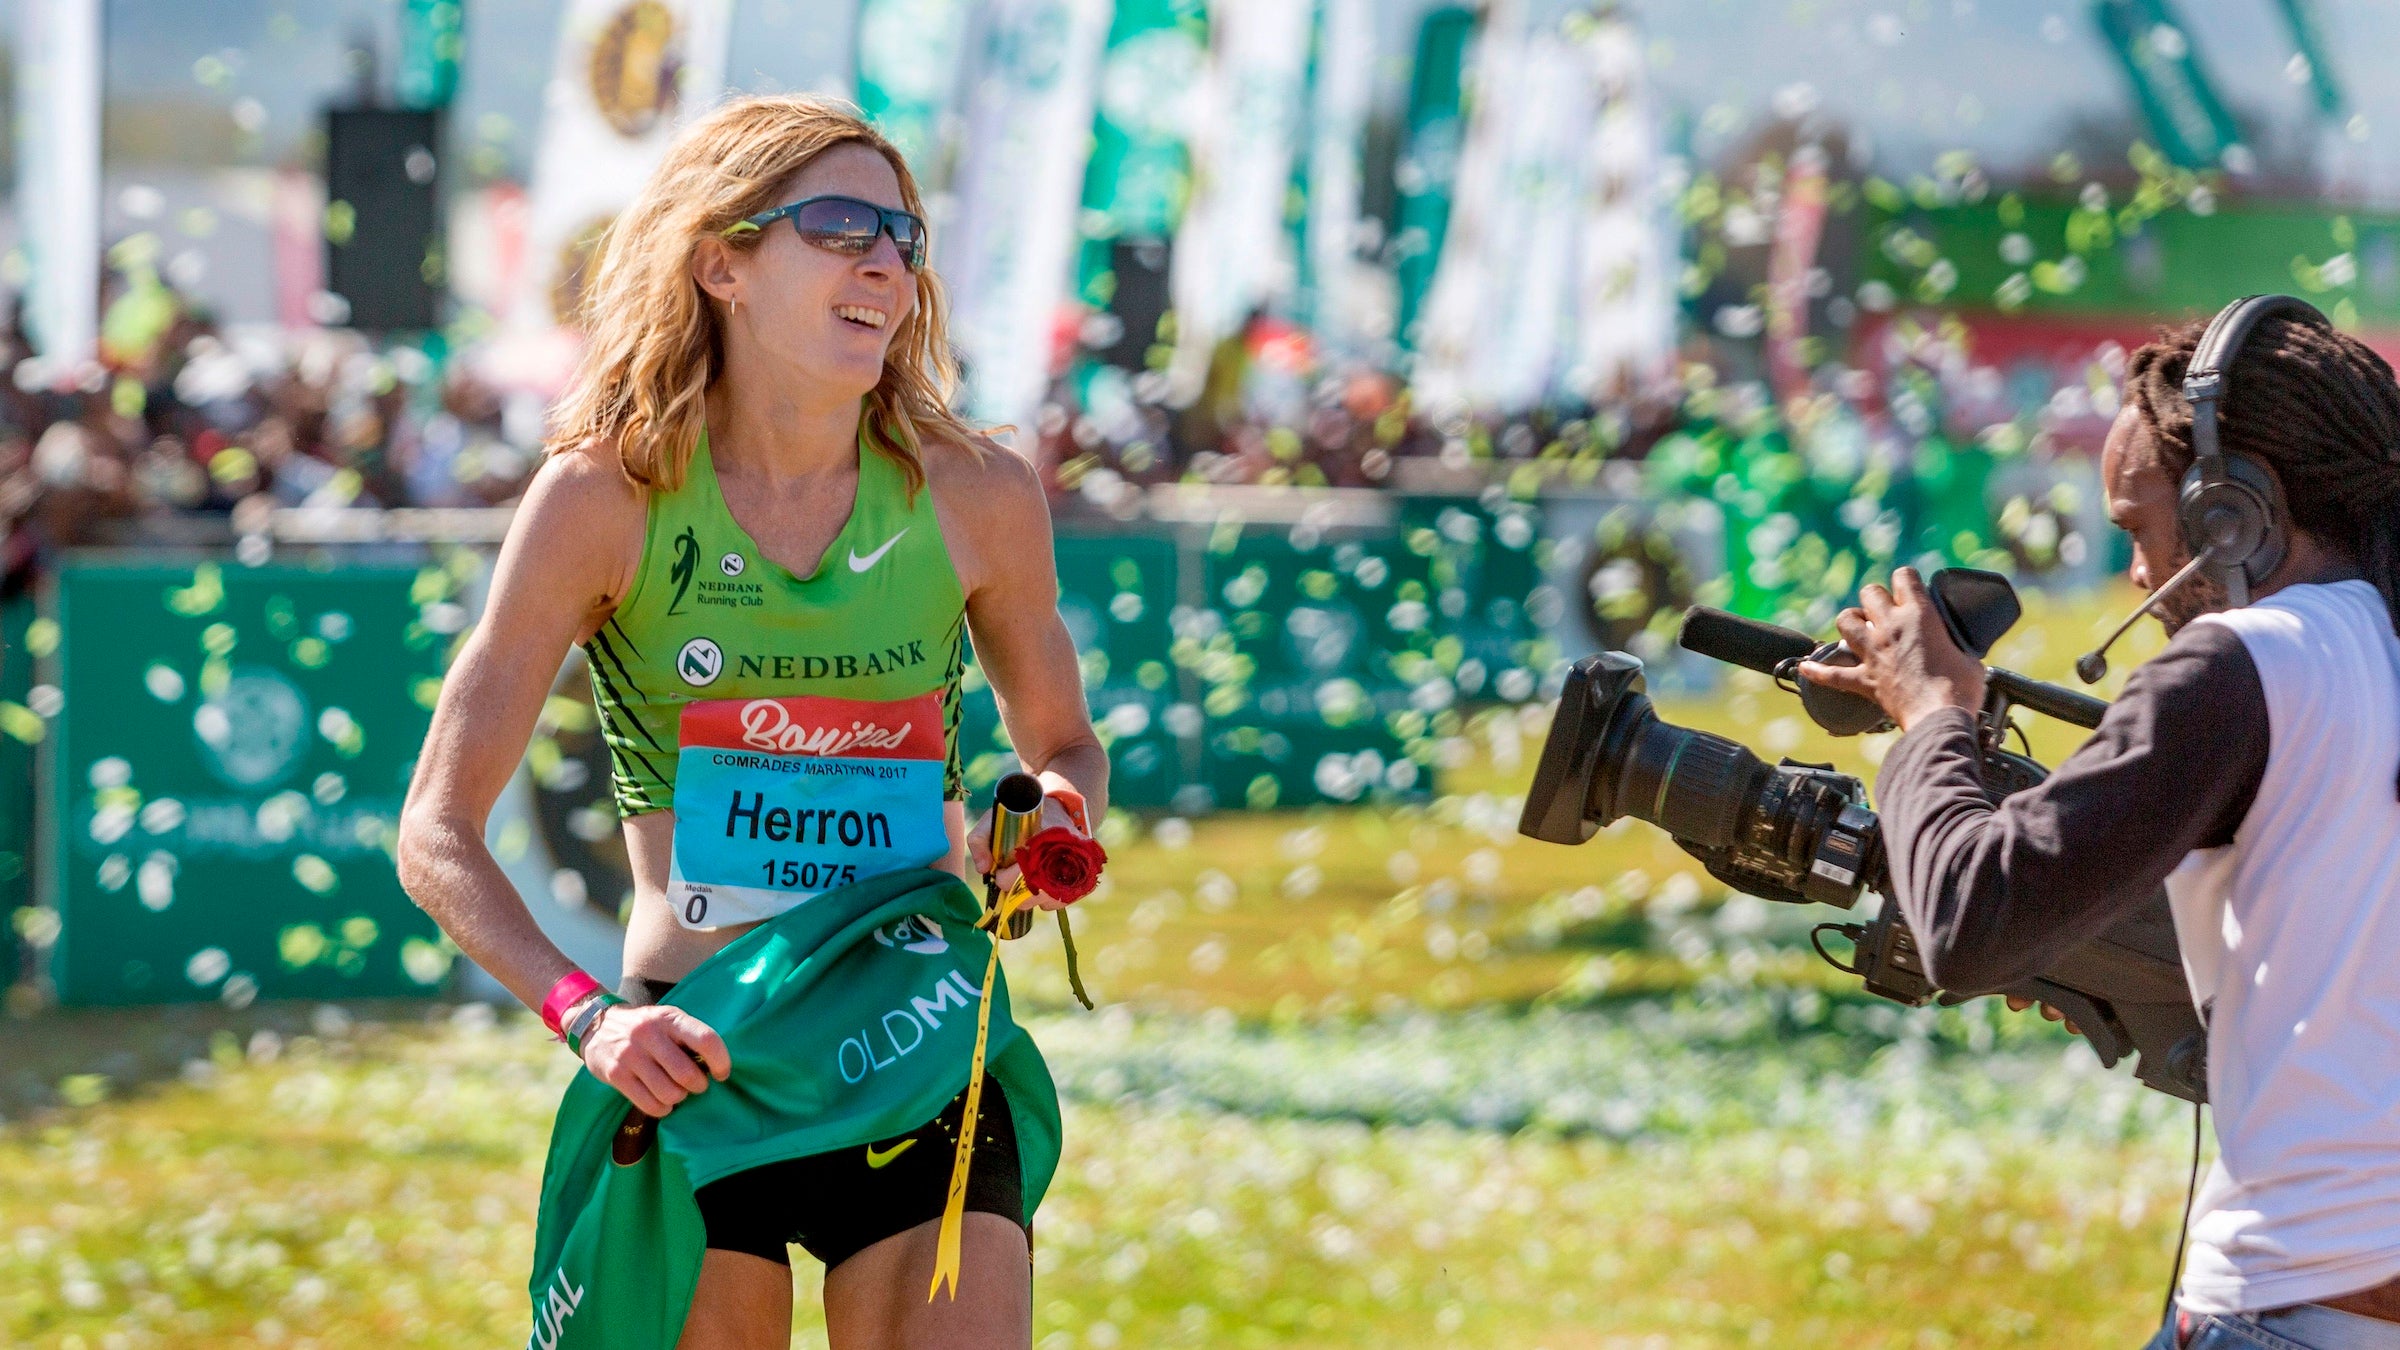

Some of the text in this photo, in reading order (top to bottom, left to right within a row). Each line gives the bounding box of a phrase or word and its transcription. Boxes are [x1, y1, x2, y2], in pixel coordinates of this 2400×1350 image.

[697, 593, 763, 608] Running Club
[698, 580, 764, 593] NEDBANK
[736, 639, 926, 679] NEDBANK
[740, 699, 912, 757] Bonitas
[712, 753, 800, 774] COMRADES
[878, 765, 908, 779] 2017
[725, 789, 892, 848] Herron
[685, 884, 713, 893] Medals
[762, 858, 857, 889] 15075
[685, 893, 708, 924] 0
